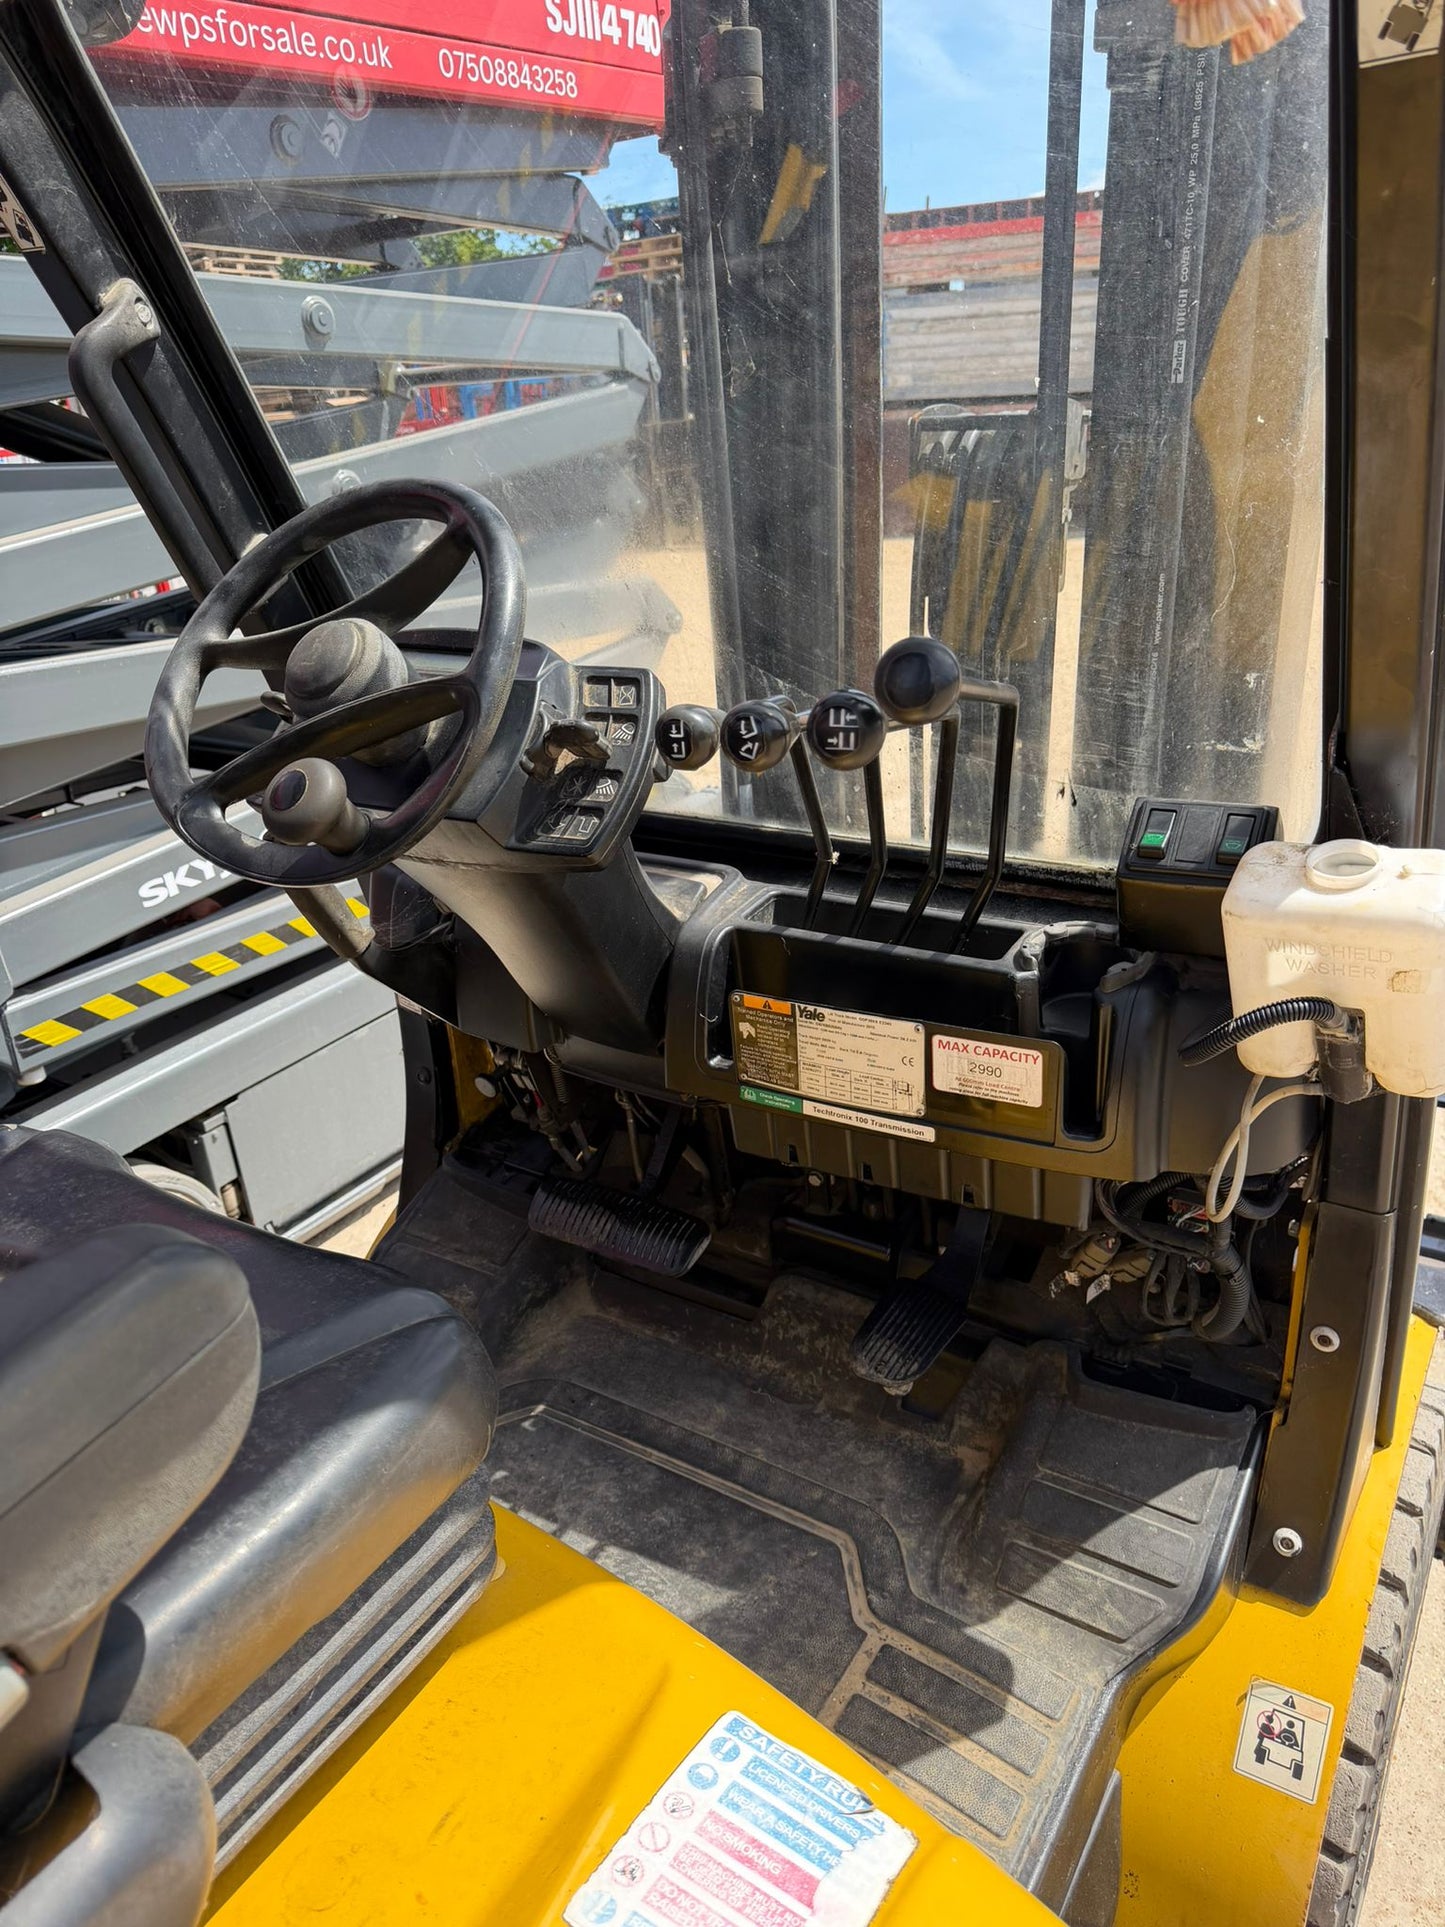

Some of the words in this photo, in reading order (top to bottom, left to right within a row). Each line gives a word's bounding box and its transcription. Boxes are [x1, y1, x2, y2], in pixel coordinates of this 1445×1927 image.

[438, 48, 578, 98] 07508843258
[1172, 342, 1184, 382] Parker
[1180, 246, 1190, 282] COVER
[1188, 170, 1196, 188] WP
[1192, 116, 1201, 138] MPa
[1153, 573, 1165, 644] www.parker.com
[138, 859, 232, 908] SKY
[1265, 937, 1392, 963] WINDSHIELD
[1286, 958, 1376, 980] WASHER
[797, 1005, 825, 1023] Yale
[938, 1039, 969, 1054] MAX
[973, 1045, 1040, 1065] CAPACITY
[969, 1061, 1002, 1079] 2990
[812, 1105, 853, 1122] Techtronix
[855, 1116, 869, 1125] 100
[871, 1119, 925, 1137] Transmission
[740, 1725, 822, 1785] SAFETY
[748, 1760, 808, 1805] LICENCED
[807, 1798, 861, 1839] DRIVERS
[727, 1788, 764, 1817] WEAR
[774, 1819, 823, 1855] SAFETY
[702, 1817, 724, 1837] NO
[722, 1830, 784, 1876] SMOKING
[676, 1892, 705, 1916] NOT
[752, 1890, 784, 1915] MUST
